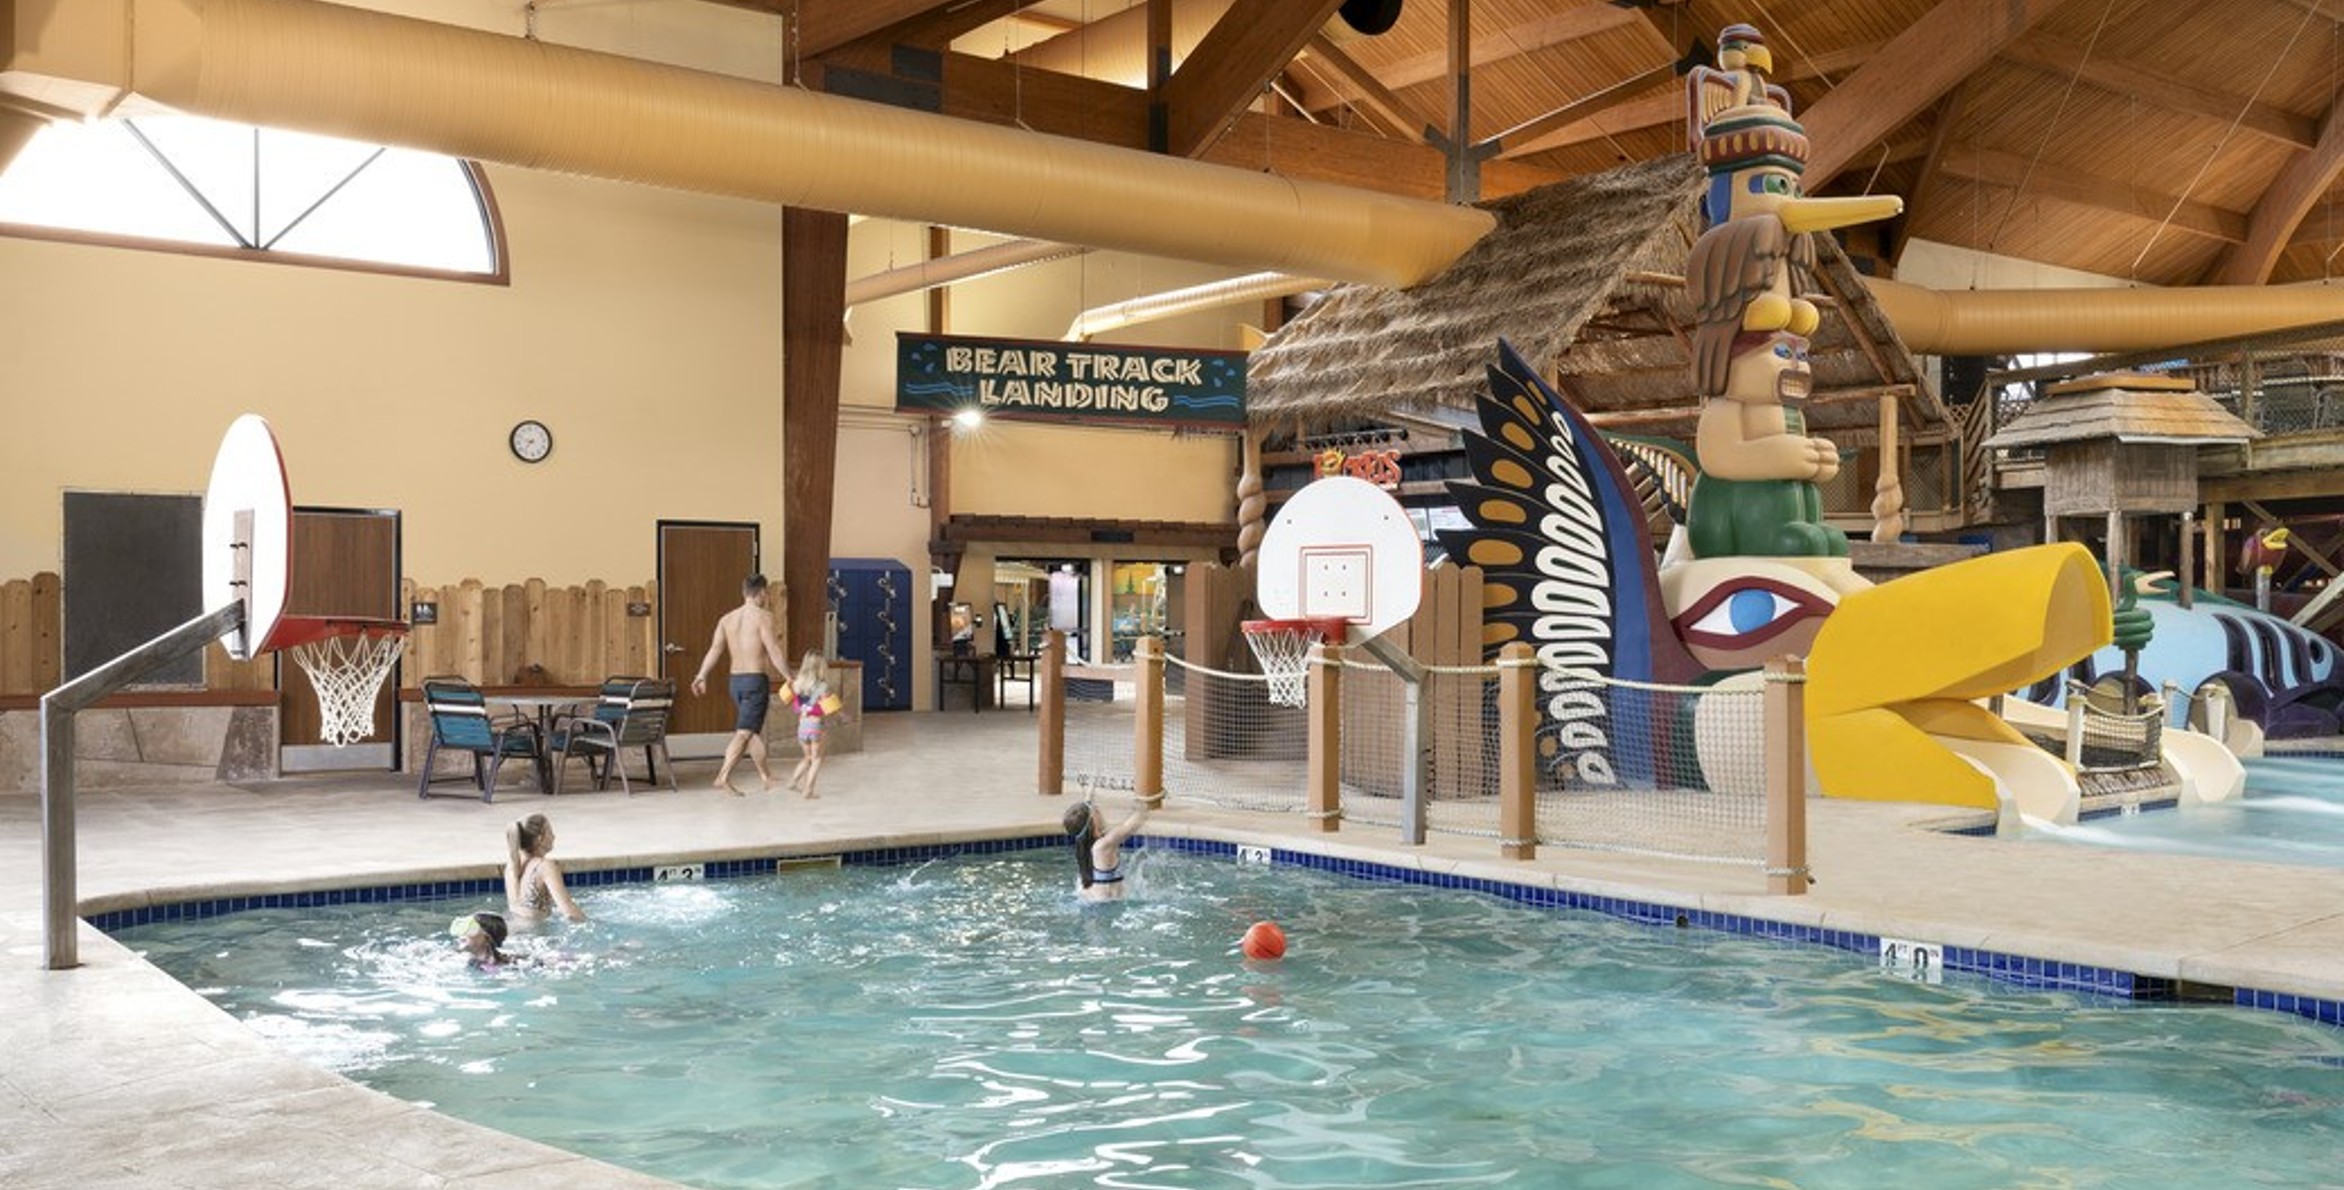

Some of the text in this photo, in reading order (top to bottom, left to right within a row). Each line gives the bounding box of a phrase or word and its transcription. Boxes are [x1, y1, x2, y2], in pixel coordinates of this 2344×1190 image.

[945, 346, 1202, 385] BEAR TRACK
[979, 379, 1168, 412] LANDING
